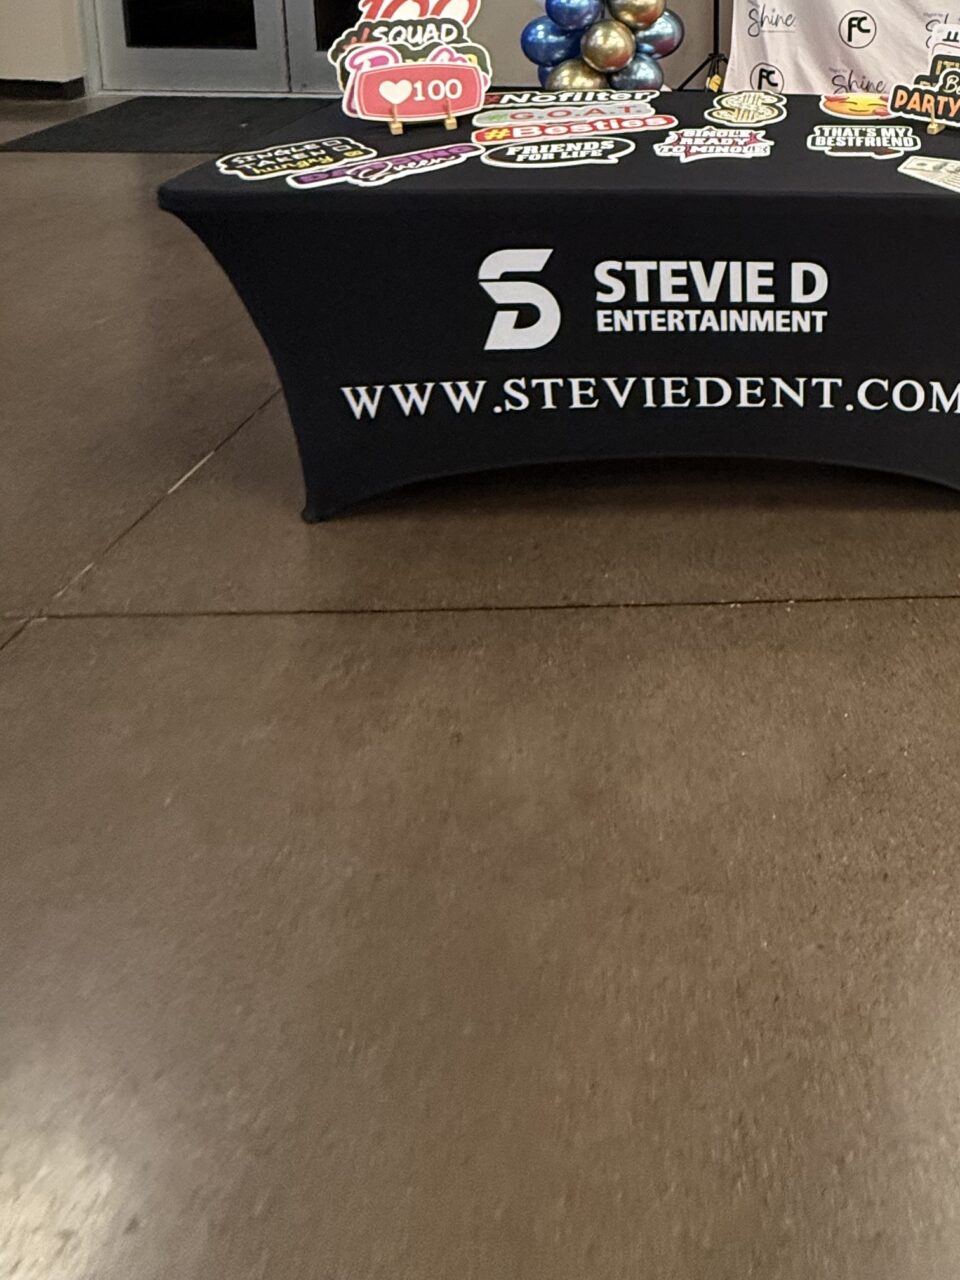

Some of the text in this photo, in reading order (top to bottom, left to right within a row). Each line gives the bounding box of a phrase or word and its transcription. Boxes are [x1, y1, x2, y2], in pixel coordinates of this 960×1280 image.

[413, 78, 463, 101] 100
[484, 117, 668, 141] #Besties
[822, 128, 905, 137] THAT'S MY
[232, 140, 320, 165] SINGLE
[505, 140, 615, 156] FRIENDS
[660, 146, 685, 154] TO
[815, 136, 914, 147] BESTFRIEND
[237, 149, 327, 171] TAKEN
[515, 149, 604, 162] FOR LIFE
[593, 259, 829, 304] STEVIE D
[596, 308, 828, 333] ENTERTAINMENT
